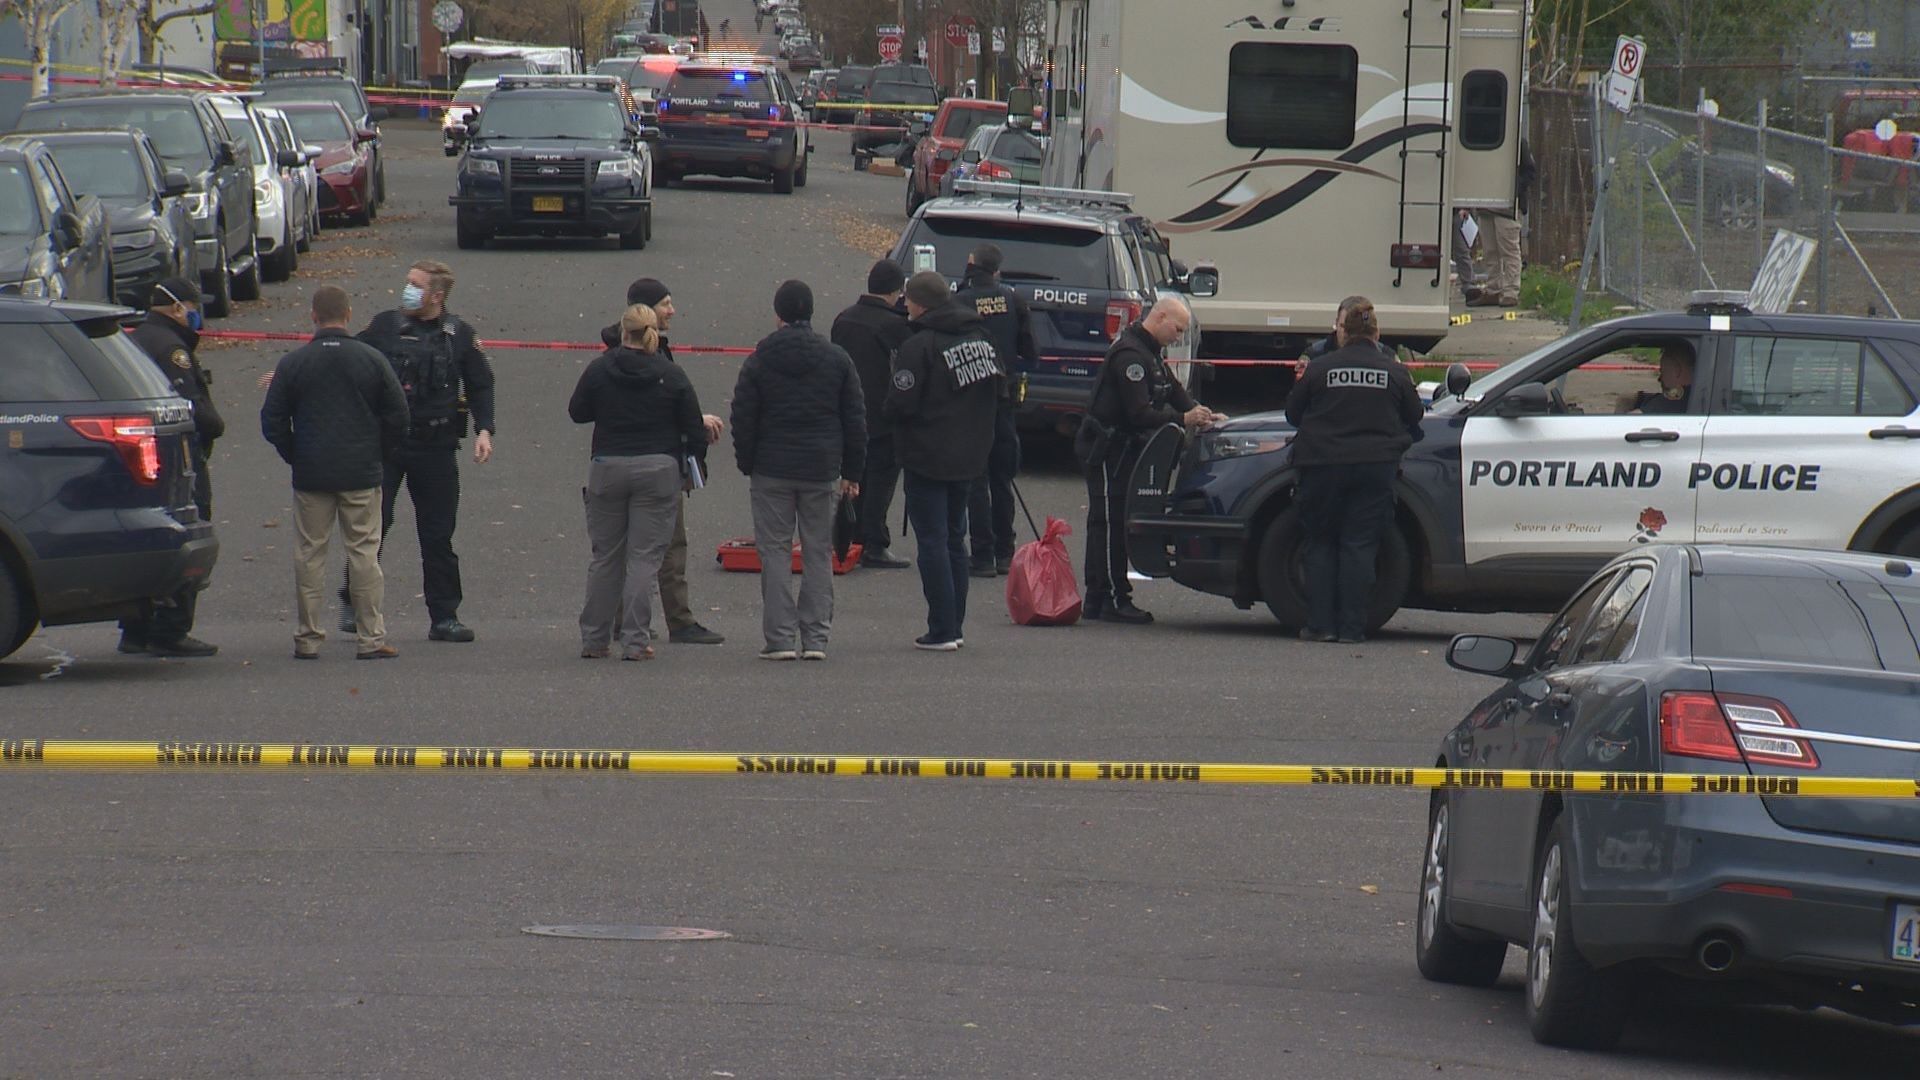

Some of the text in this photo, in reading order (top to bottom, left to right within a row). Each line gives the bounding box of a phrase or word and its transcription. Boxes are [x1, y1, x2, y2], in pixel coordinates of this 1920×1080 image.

[880, 42, 902, 53] STOP
[671, 98, 708, 106] PORTLAND
[976, 296, 1006, 307] PORTLAND
[1034, 289, 1087, 305] POLICE
[977, 303, 1007, 315] POLICE
[1329, 370, 1386, 386] POLICE
[0, 413, 60, 425] tlandPolice
[1469, 460, 1821, 491] PORTLAND POLICE
[1513, 522, 1603, 533] Sworn to Protect
[1696, 523, 1789, 535] Dedicated to Serve
[288, 745, 349, 765] NOT
[374, 746, 416, 766] DO
[440, 748, 502, 767] LINE
[528, 750, 630, 769] POLICE
[736, 757, 1200, 781] POLICE LINE DO NOT CROSS
[1311, 767, 1798, 793] POLICE LINE DO NOT CROSS
